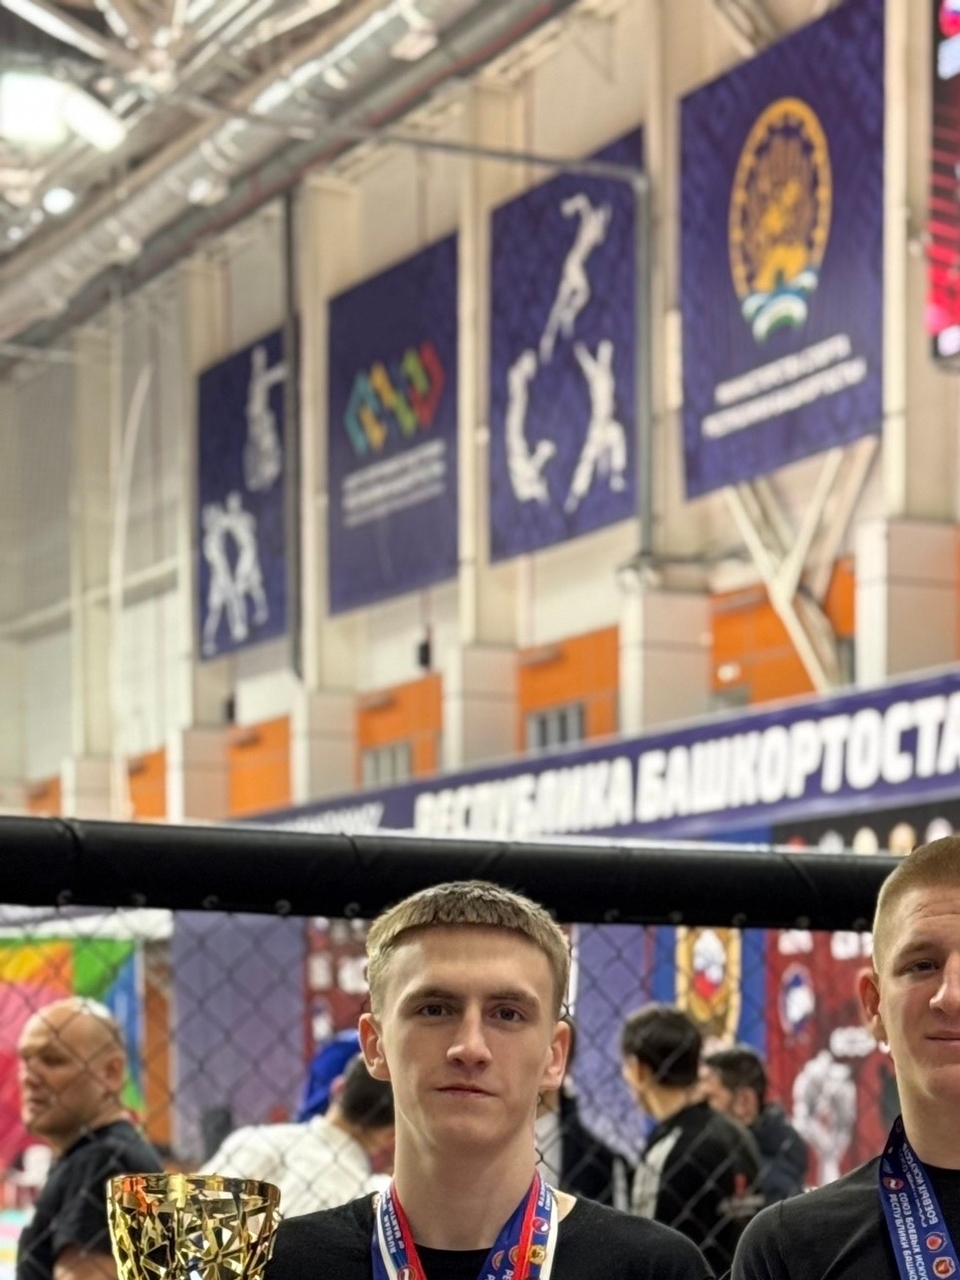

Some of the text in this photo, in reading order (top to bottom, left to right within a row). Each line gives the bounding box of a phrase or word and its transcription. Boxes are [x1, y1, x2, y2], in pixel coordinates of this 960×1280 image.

[888, 1193, 909, 1249] РЕСПУБЛИКИ
[898, 1192, 912, 1215] СОЮЗ
[904, 1216, 922, 1254] БОЕВЫХ
